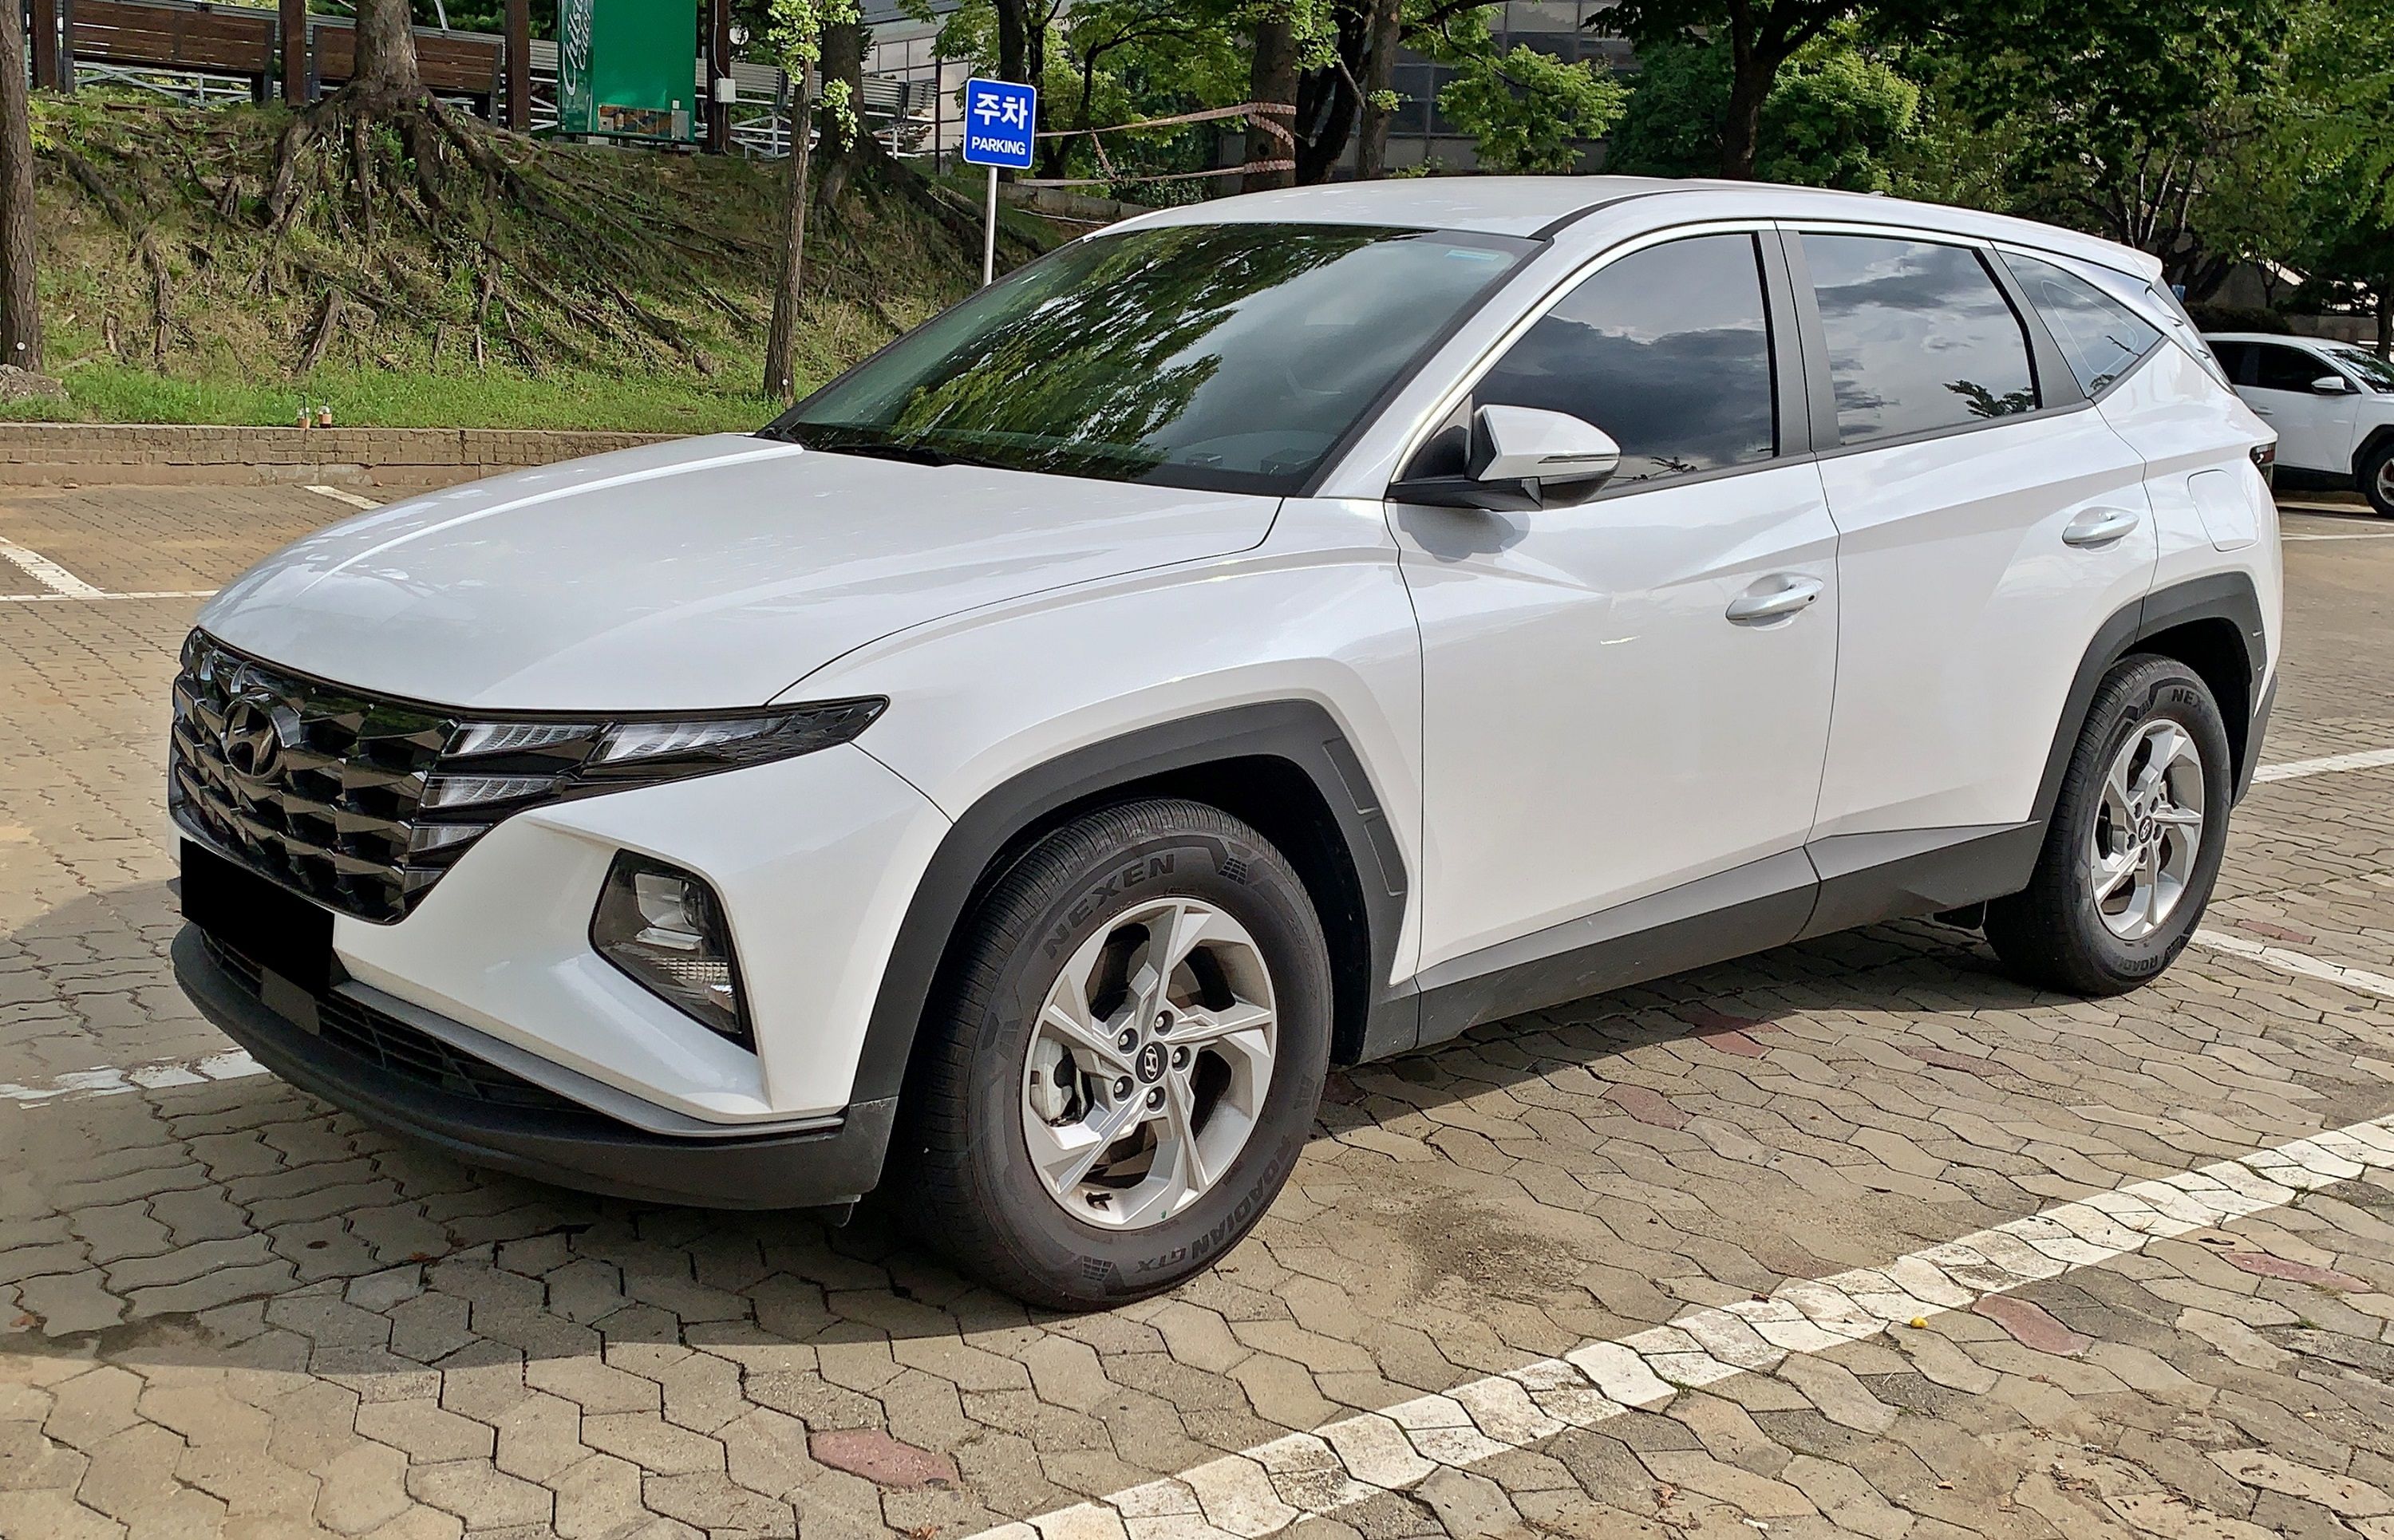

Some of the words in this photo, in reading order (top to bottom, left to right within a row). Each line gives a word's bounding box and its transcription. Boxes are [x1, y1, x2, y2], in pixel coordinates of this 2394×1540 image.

[974, 93, 1029, 130] 주차
[971, 136, 1025, 156] PARKING
[1043, 853, 1175, 959] NEXEN
